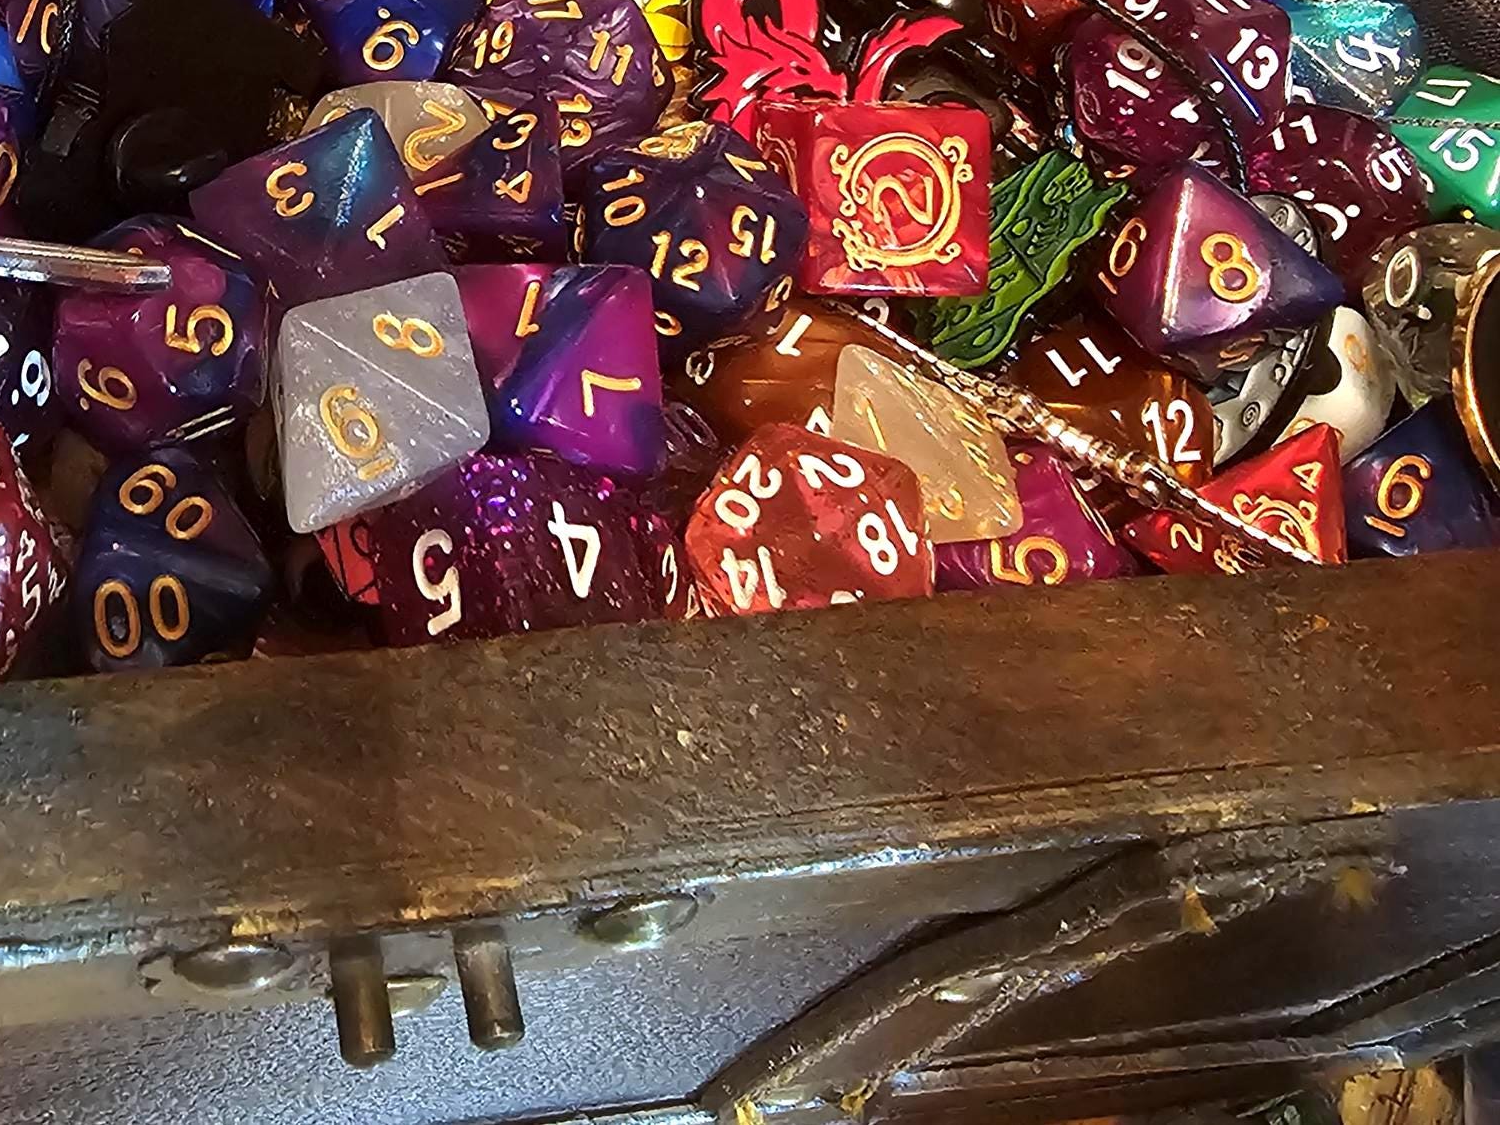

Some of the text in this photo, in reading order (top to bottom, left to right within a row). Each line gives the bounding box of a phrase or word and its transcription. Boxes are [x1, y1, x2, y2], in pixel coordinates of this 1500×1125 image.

[589, 30, 632, 85] 11
[1227, 29, 1279, 91] 13
[494, 113, 537, 150] 3
[1429, 129, 1495, 171] 15
[604, 169, 645, 226] 10
[653, 232, 709, 291] 12
[1201, 233, 1259, 302] 8
[166, 305, 233, 356] 5
[373, 314, 444, 357] 8
[1045, 337, 1122, 388] 11
[580, 369, 641, 416] 7
[1143, 400, 1202, 463] 12
[716, 455, 782, 527] 20
[799, 454, 865, 490] 2
[119, 464, 212, 540] 60
[549, 501, 600, 598] 4
[858, 500, 920, 574] 18
[990, 536, 1067, 584] 5
[413, 530, 462, 636] 5
[94, 575, 191, 658] 00
